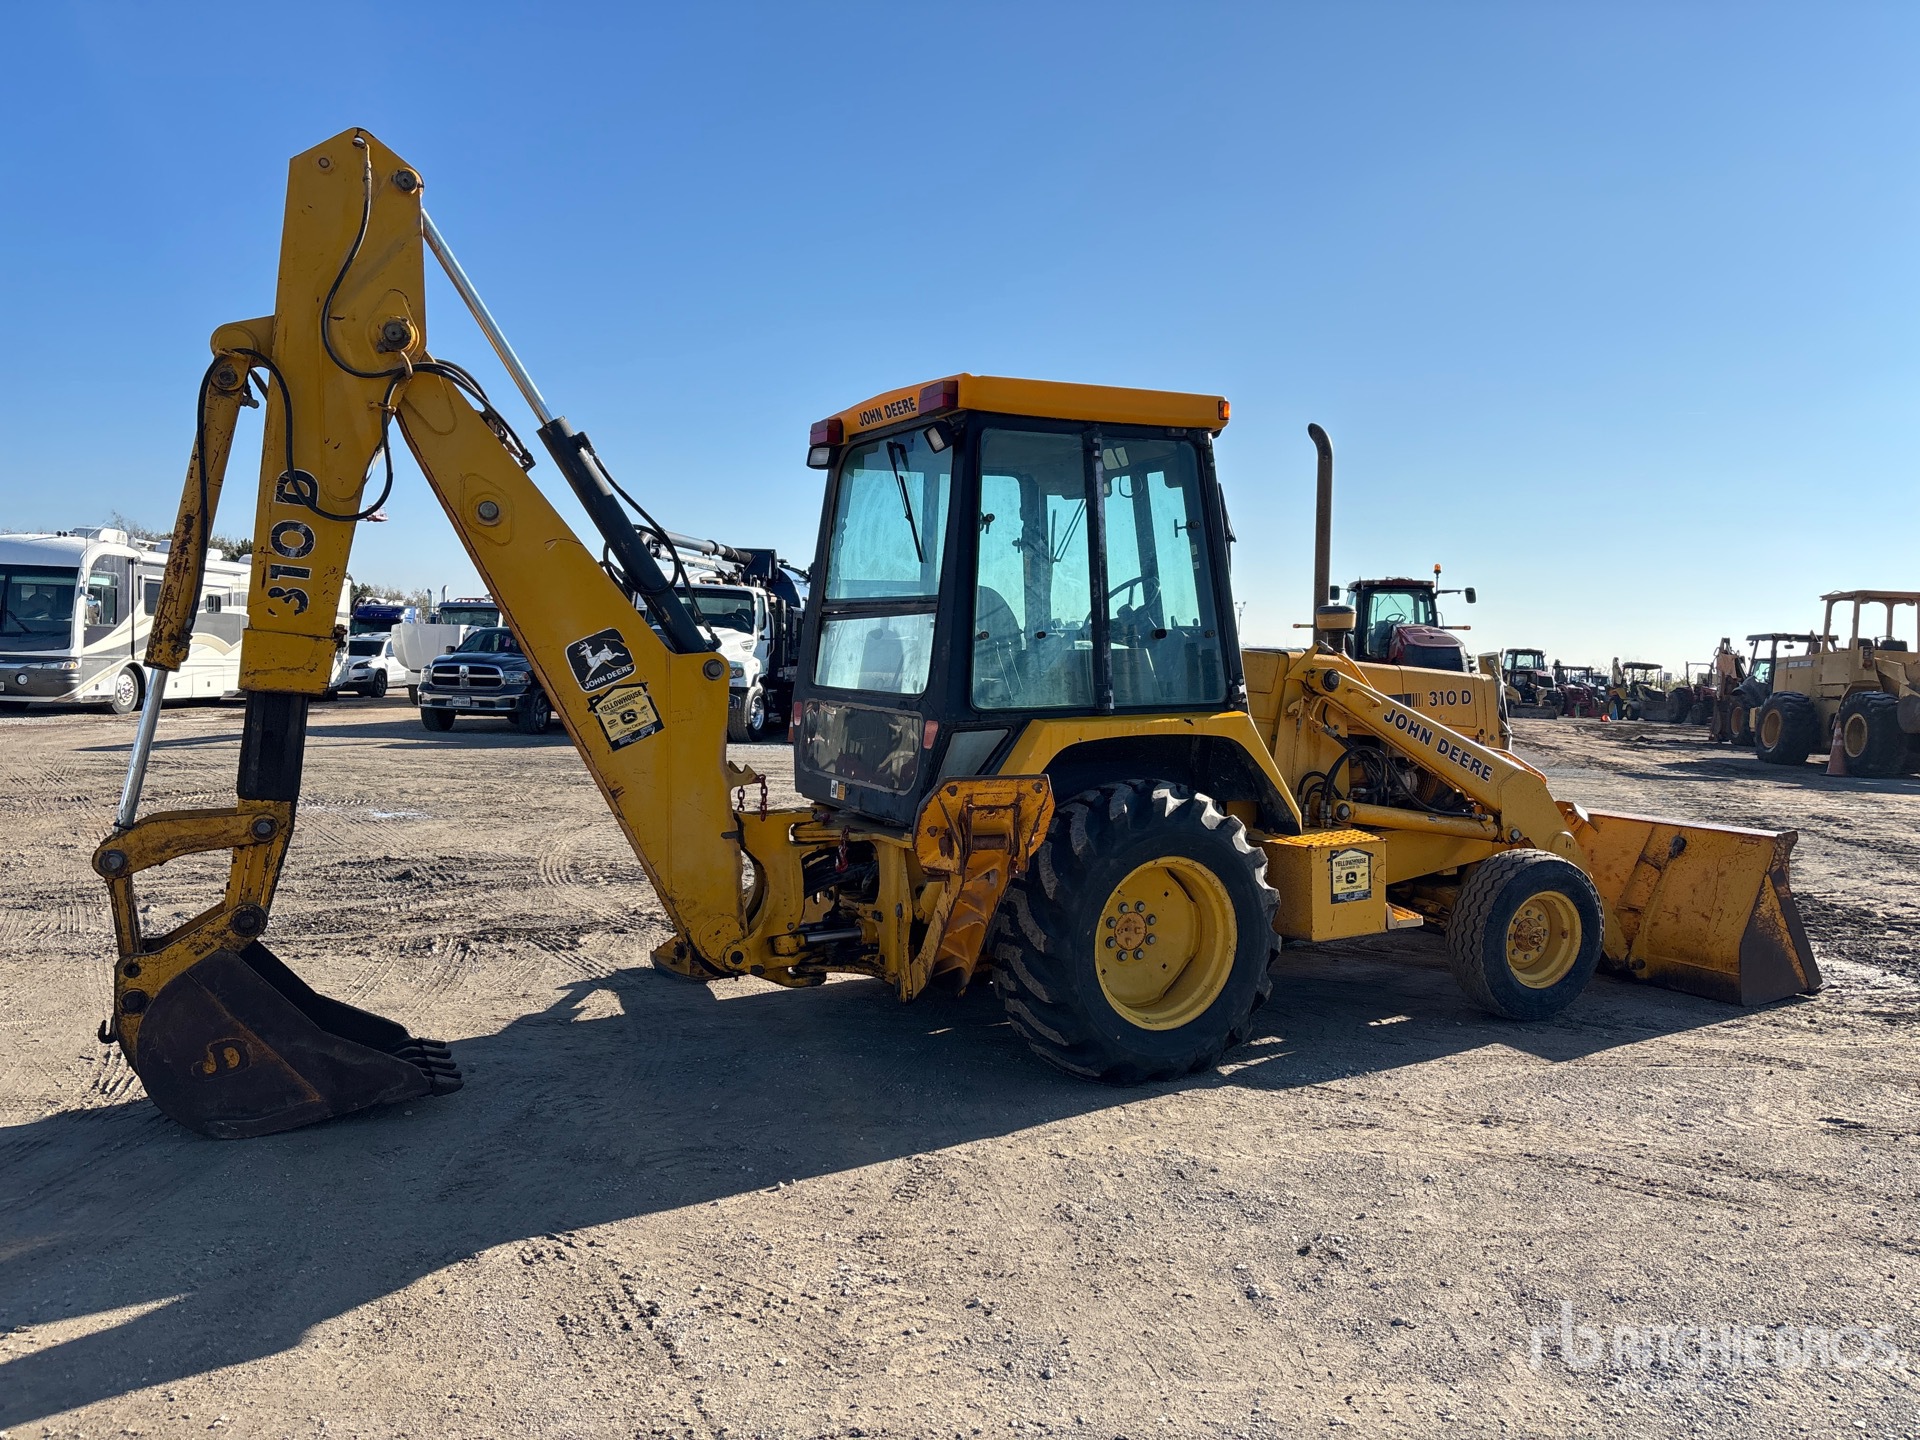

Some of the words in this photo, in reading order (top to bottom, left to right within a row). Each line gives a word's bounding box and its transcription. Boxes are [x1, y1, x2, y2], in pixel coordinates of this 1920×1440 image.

[859, 407, 884, 427] JOHN
[883, 396, 917, 419] DEERE
[274, 468, 319, 507] D
[267, 519, 316, 618] 310
[584, 676, 606, 689] JOHN
[606, 665, 632, 680] DEERE
[599, 690, 642, 712] YELLOWHOUSE
[1428, 690, 1458, 707] 310
[1461, 690, 1472, 705] D
[1383, 708, 1433, 747] JOHN
[1436, 738, 1494, 783] DEERE
